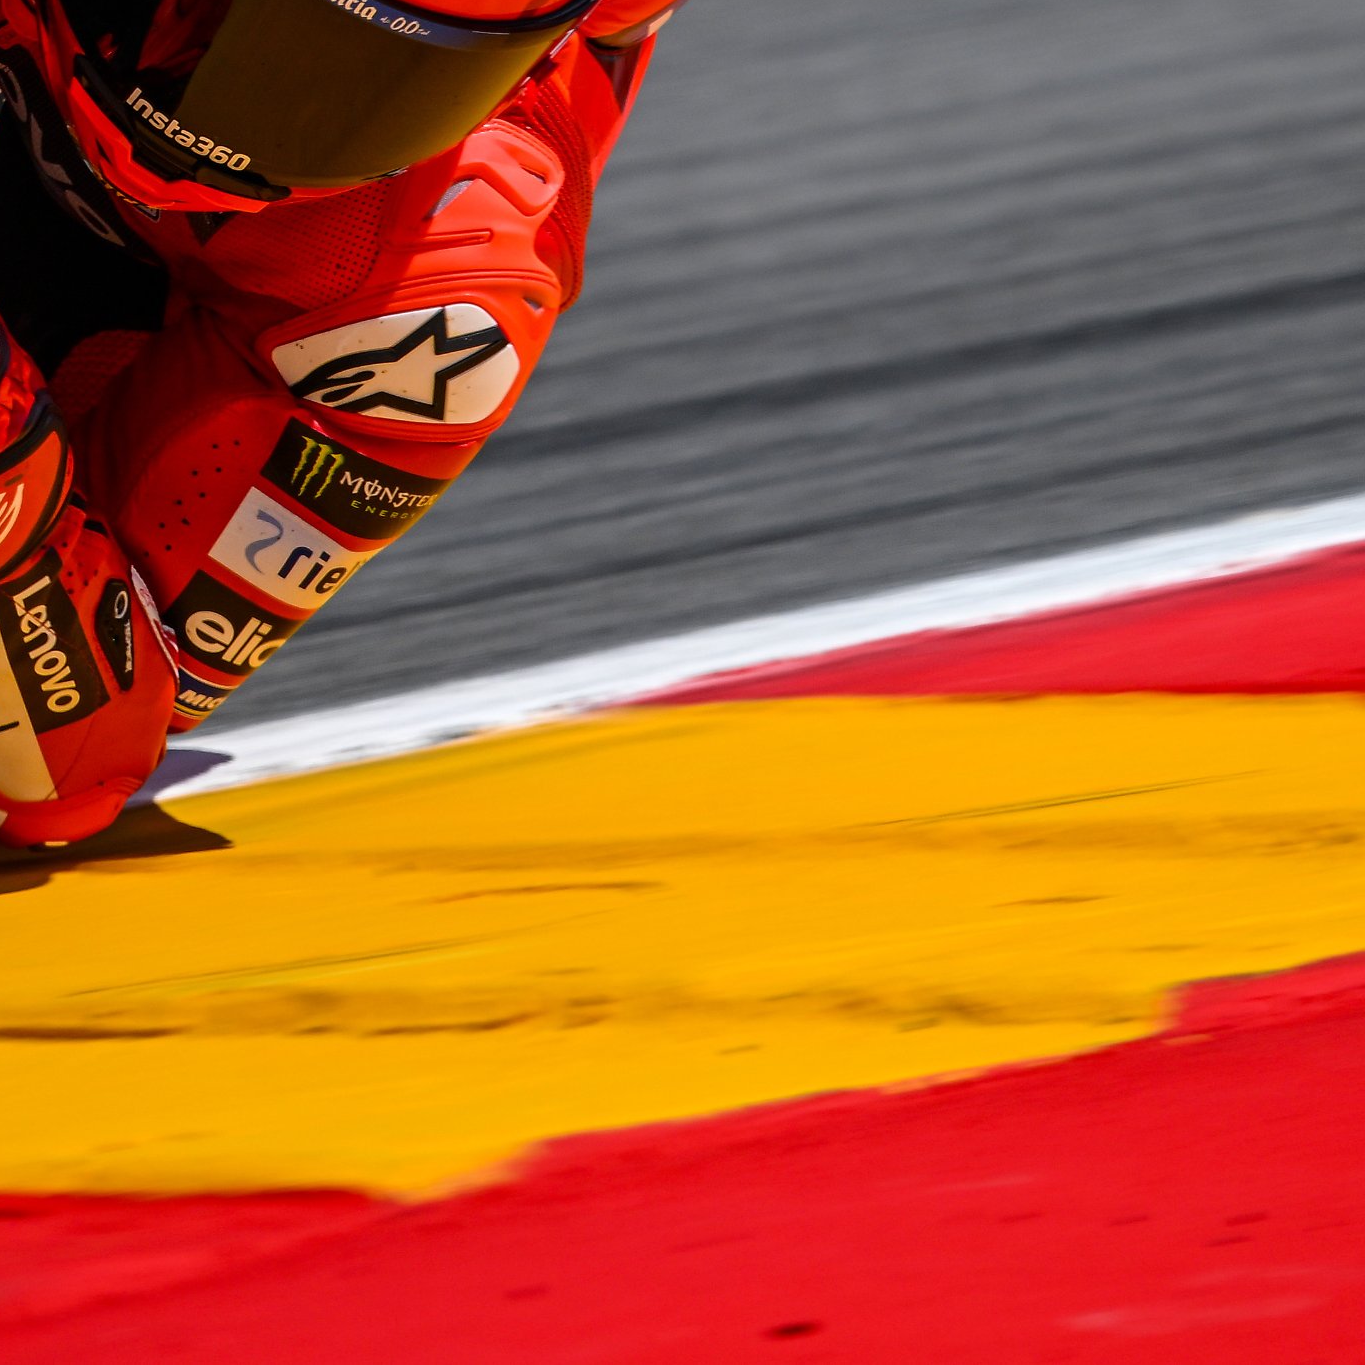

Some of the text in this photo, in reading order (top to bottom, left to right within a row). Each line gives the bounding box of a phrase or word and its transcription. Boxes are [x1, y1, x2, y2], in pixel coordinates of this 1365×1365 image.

[126, 87, 251, 171] Insta360
[13, 575, 80, 713] Lenovo
[185, 610, 288, 668] elic
